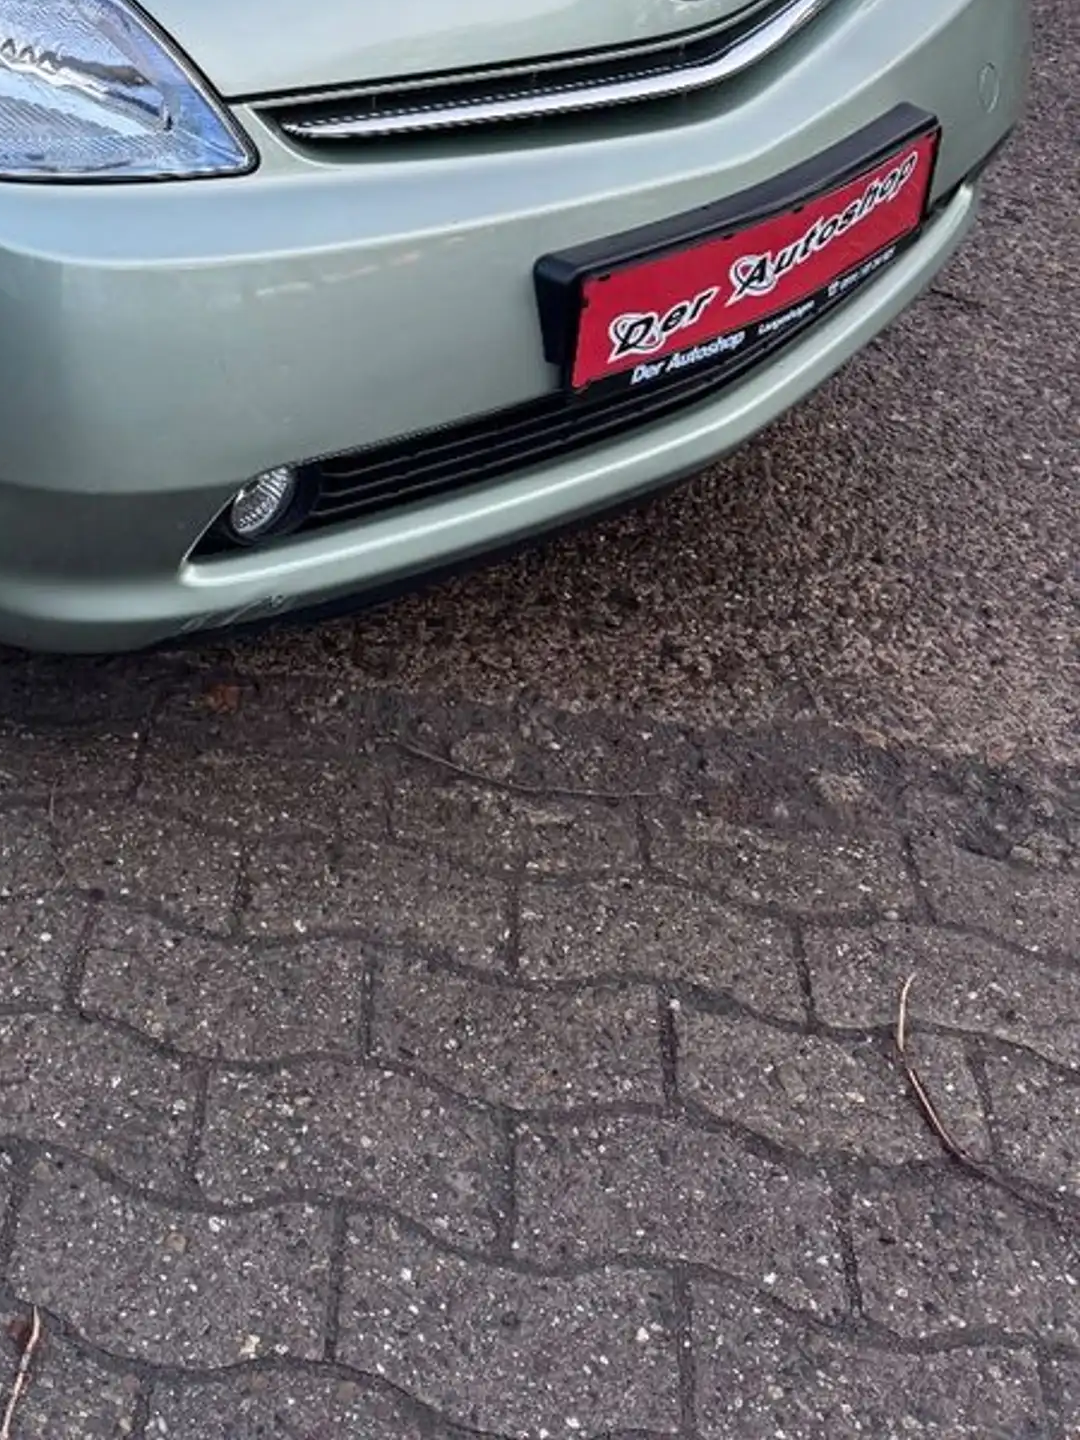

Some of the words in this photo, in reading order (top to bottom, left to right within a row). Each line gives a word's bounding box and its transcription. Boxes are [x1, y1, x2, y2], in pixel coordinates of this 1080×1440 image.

[608, 287, 719, 363] Der
[725, 152, 919, 307] Autoshop
[630, 361, 664, 385] Der
[666, 330, 747, 372] Autoshop
